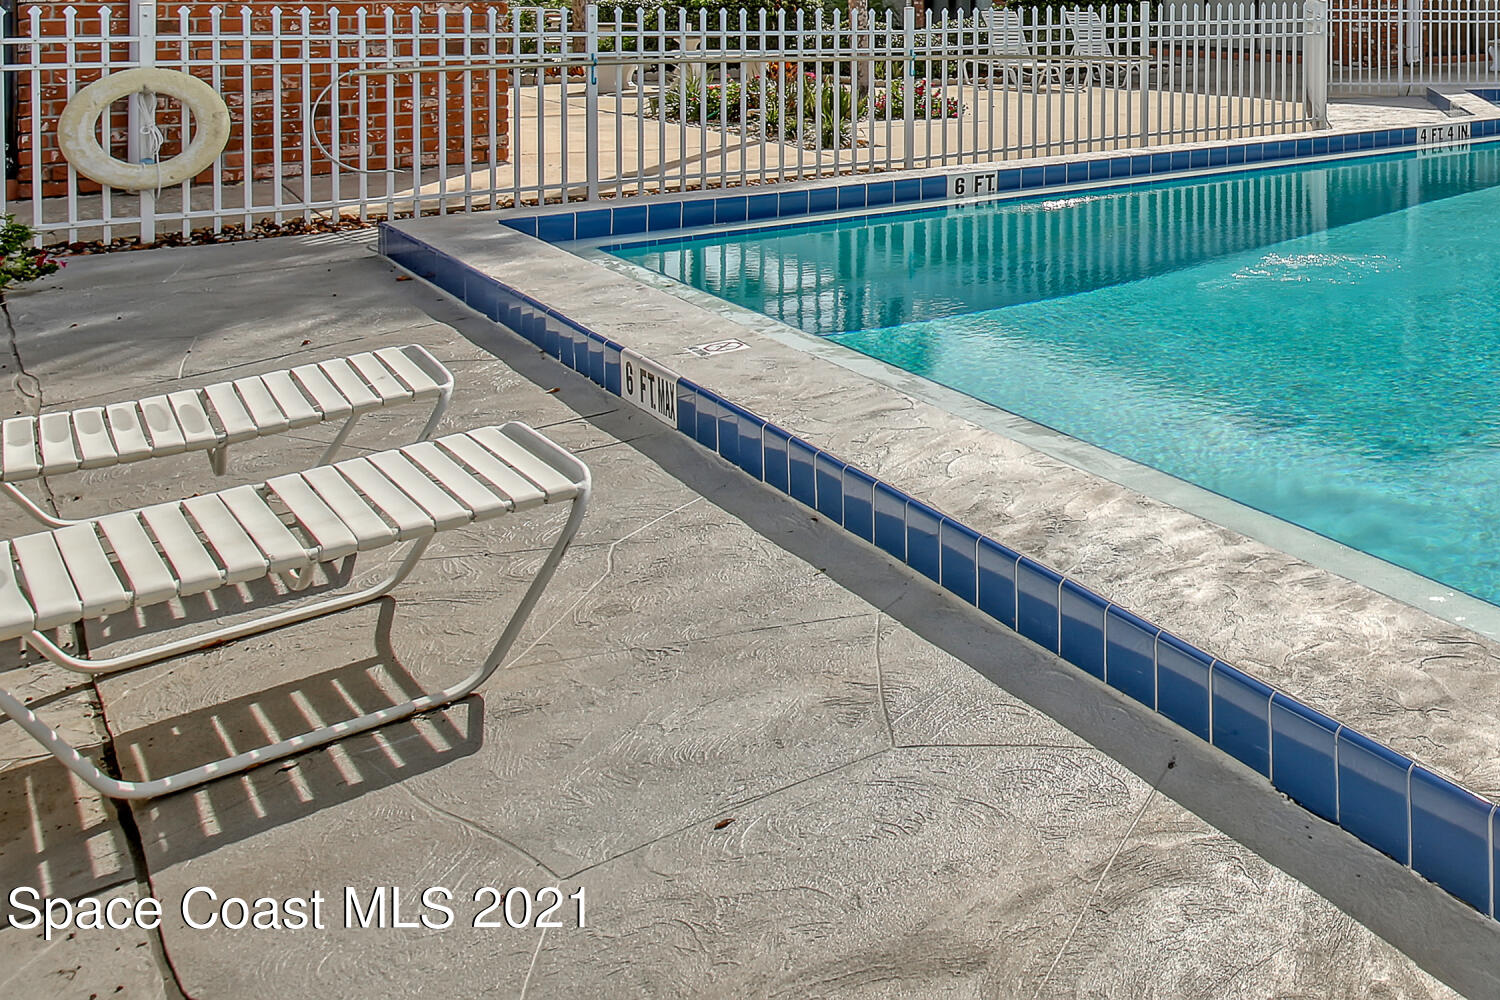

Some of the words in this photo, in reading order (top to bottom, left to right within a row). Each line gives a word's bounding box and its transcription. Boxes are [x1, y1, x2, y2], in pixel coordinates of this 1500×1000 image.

[1421, 128, 1427, 142] 4
[1448, 126, 1453, 140] 4
[955, 177, 965, 195] 6
[974, 173, 996, 193] FT.
[625, 361, 634, 396] 6
[657, 376, 676, 422] MAX
